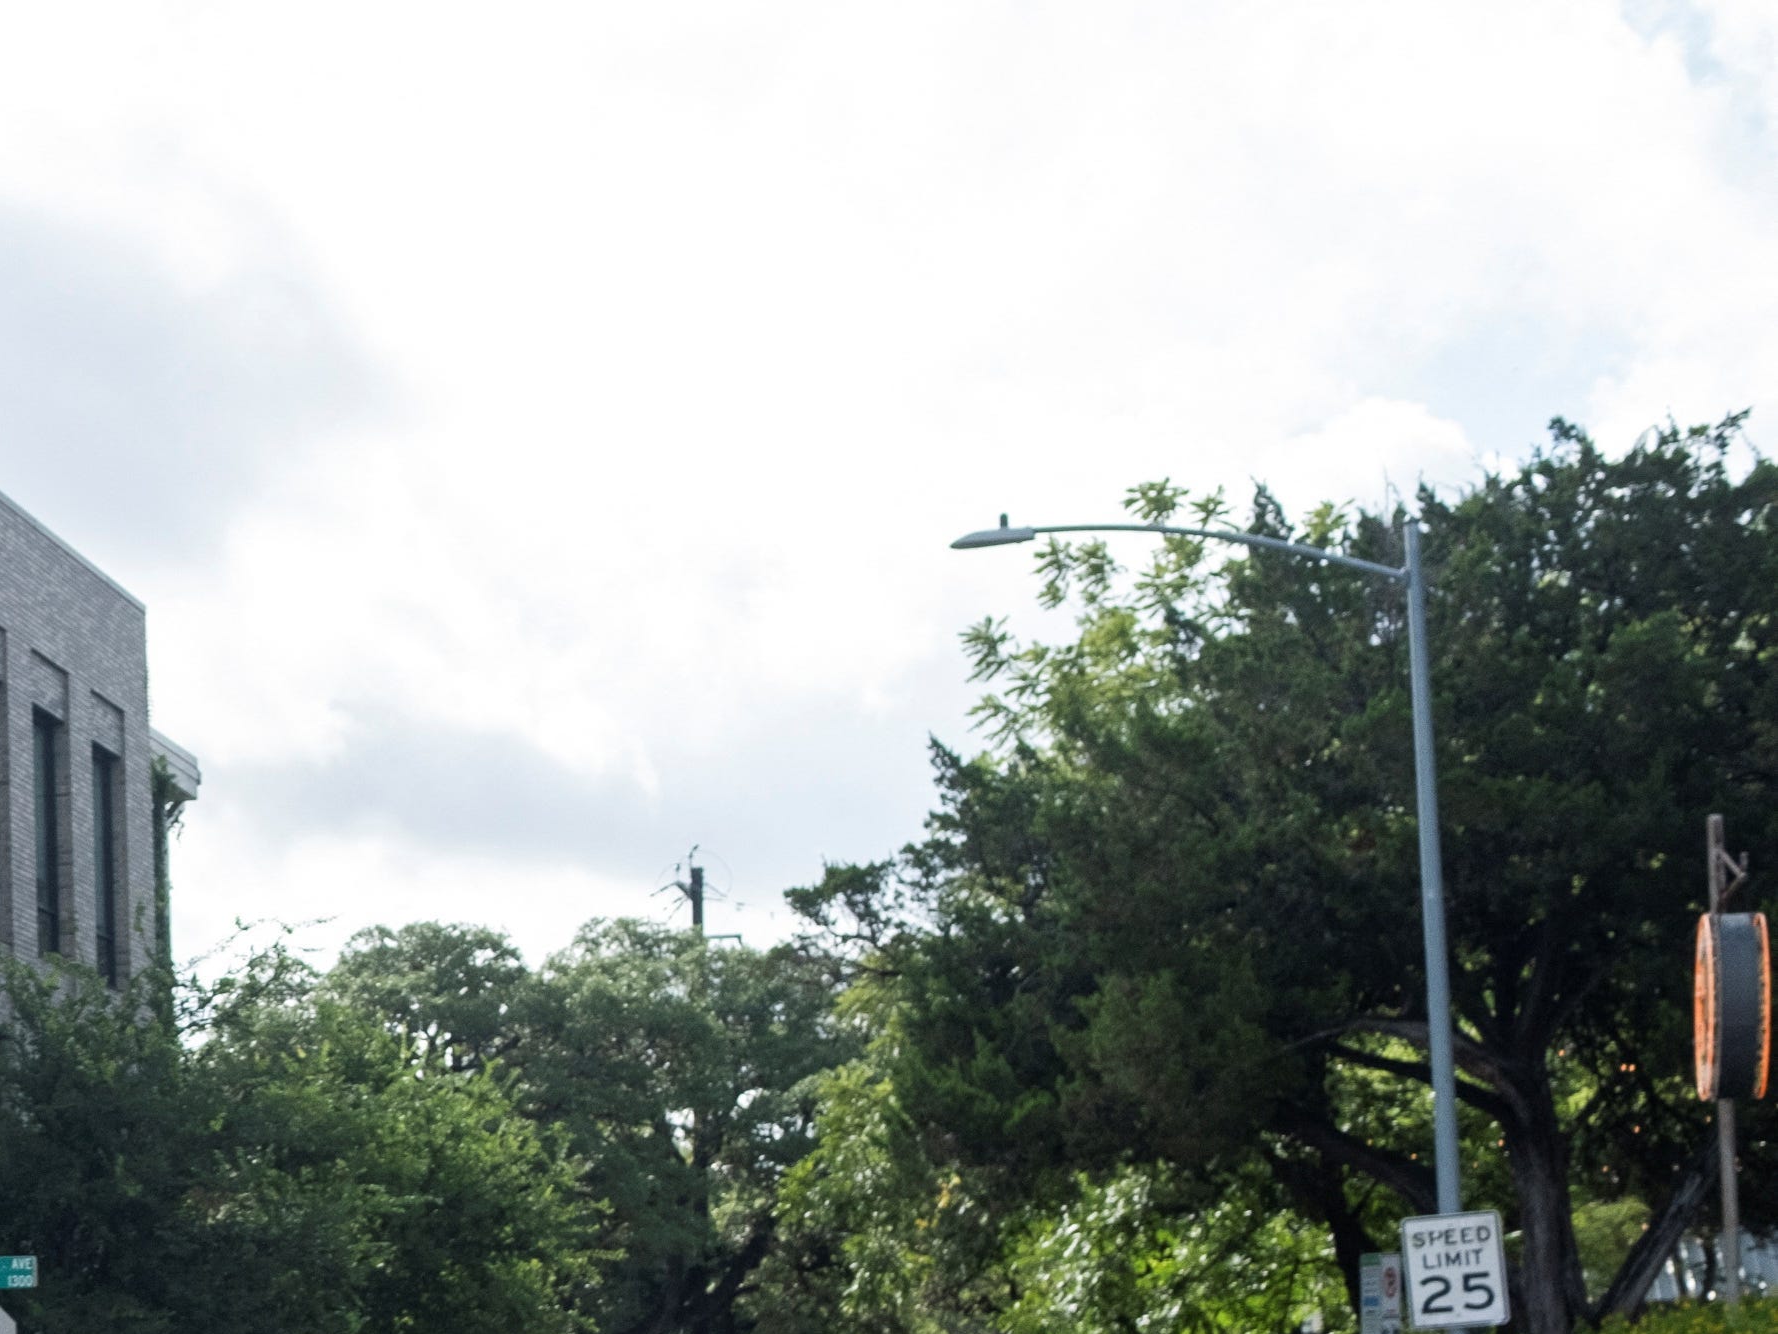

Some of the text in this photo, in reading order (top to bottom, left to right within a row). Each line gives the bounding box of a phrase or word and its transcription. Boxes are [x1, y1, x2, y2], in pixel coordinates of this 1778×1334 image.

[1412, 1226, 1491, 1248] SPEED
[12, 1258, 32, 1270] AVE
[1423, 1249, 1483, 1269] LIMIT
[8, 1275, 33, 1287] 1300
[1420, 1271, 1496, 1315] 25
